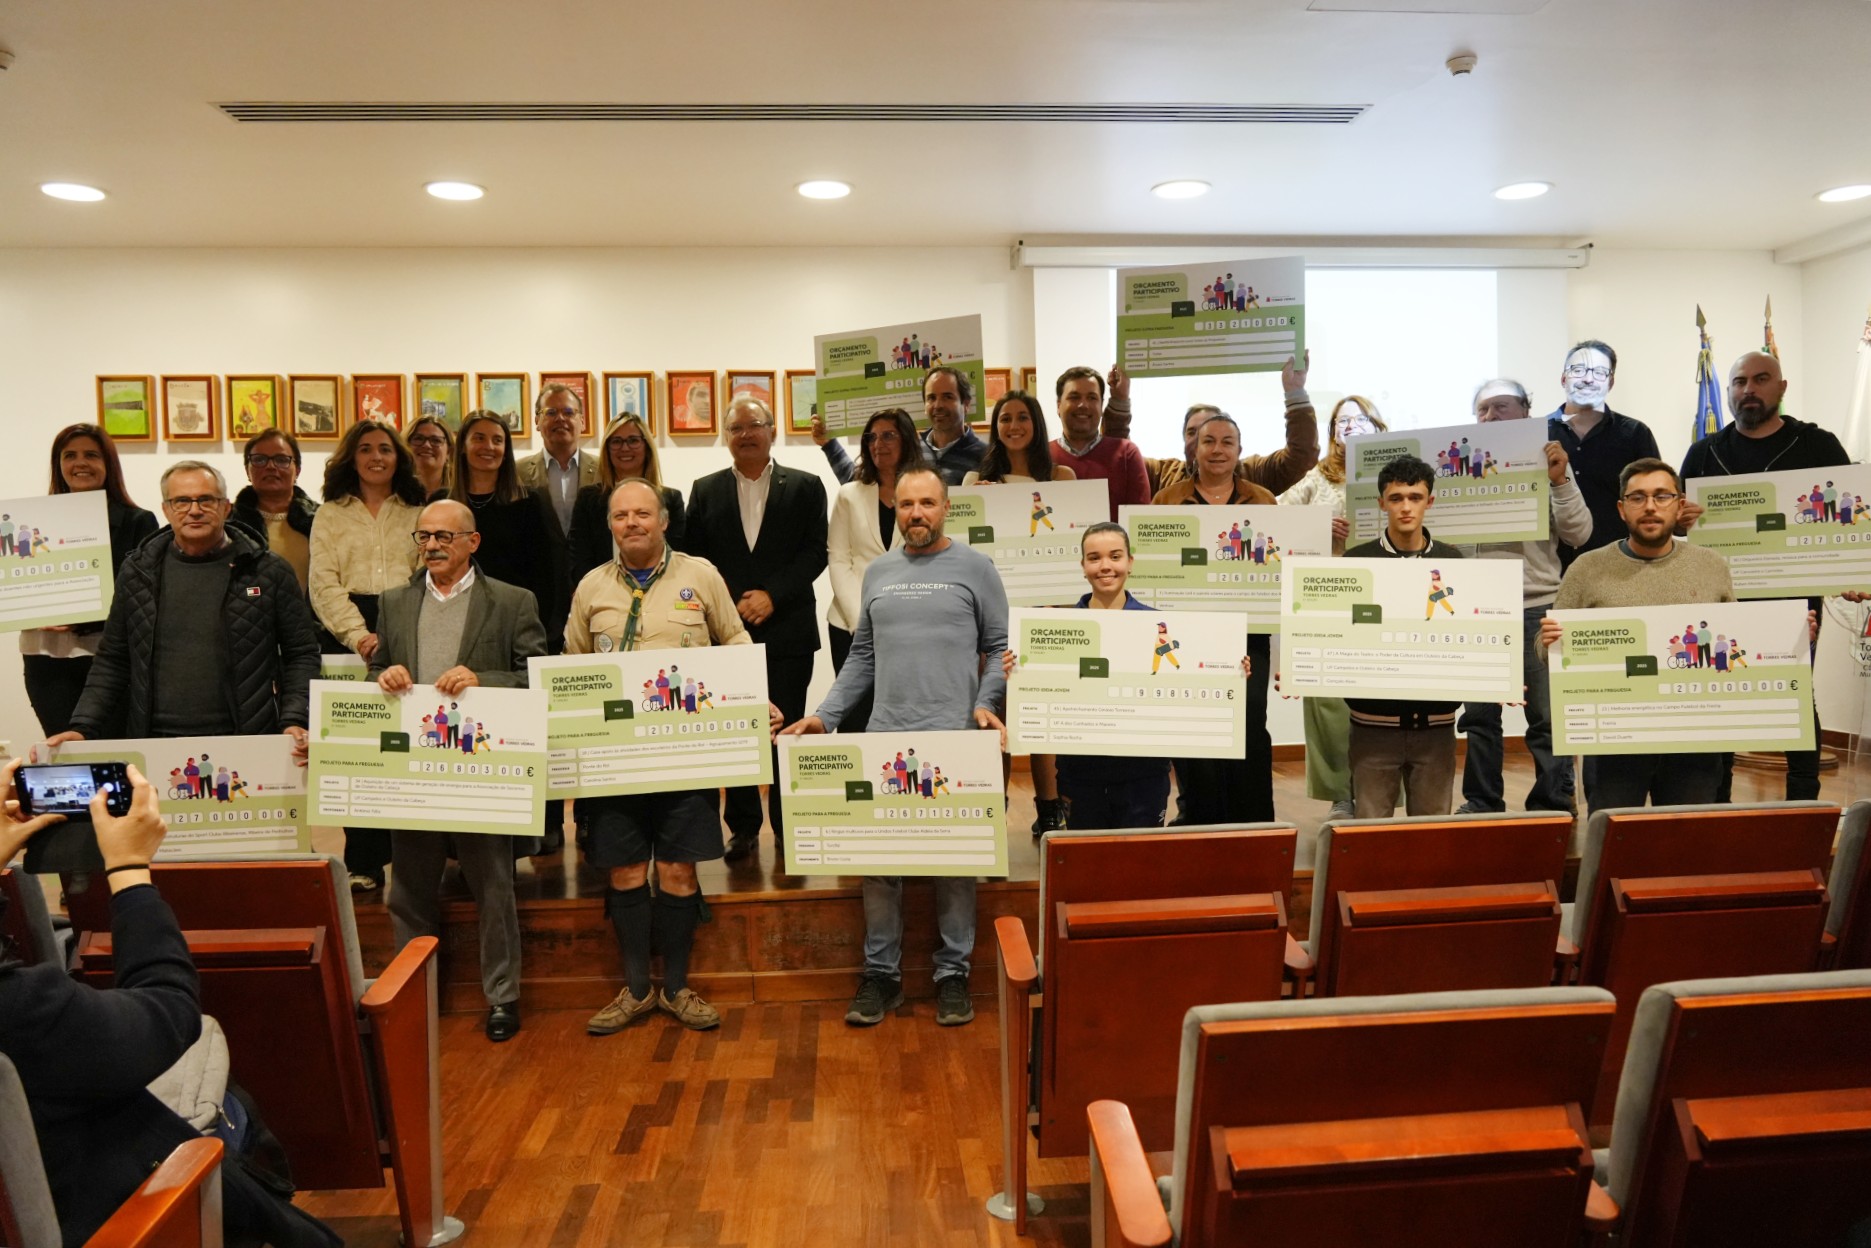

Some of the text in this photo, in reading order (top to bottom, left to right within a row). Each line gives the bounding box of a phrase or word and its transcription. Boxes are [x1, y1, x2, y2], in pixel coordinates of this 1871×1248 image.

[1133, 287, 1180, 296] PARTICIPATIVO
[830, 350, 871, 360] PARTICIPATIVO
[1363, 447, 1408, 456] ORÇAMENTO
[1707, 491, 1760, 501] ORÇAMENTO
[1707, 498, 1766, 508] PARTICIPATIVO
[1138, 524, 1186, 532] ORÇAMENTO
[1303, 577, 1357, 587] ORÇAMENTO
[882, 584, 908, 592] TIFFOSI
[1303, 585, 1363, 594] PARTICIPATIVO
[1031, 628, 1085, 639] ORÇAMENTO
[1571, 629, 1630, 639] ORÇAMENTO
[1031, 637, 1090, 646] PARTICIPATIVO
[1571, 637, 1636, 646] PARTICIPATIVO
[552, 674, 607, 684] ORÇAMENTO
[552, 682, 613, 693] PARTICIPATIVO
[332, 702, 386, 712] ORÇAMENTO
[332, 710, 392, 720] PARTICIPATIVO
[798, 754, 848, 764] ORÇAMENTO
[799, 762, 854, 771] PARTICIPATIVO
